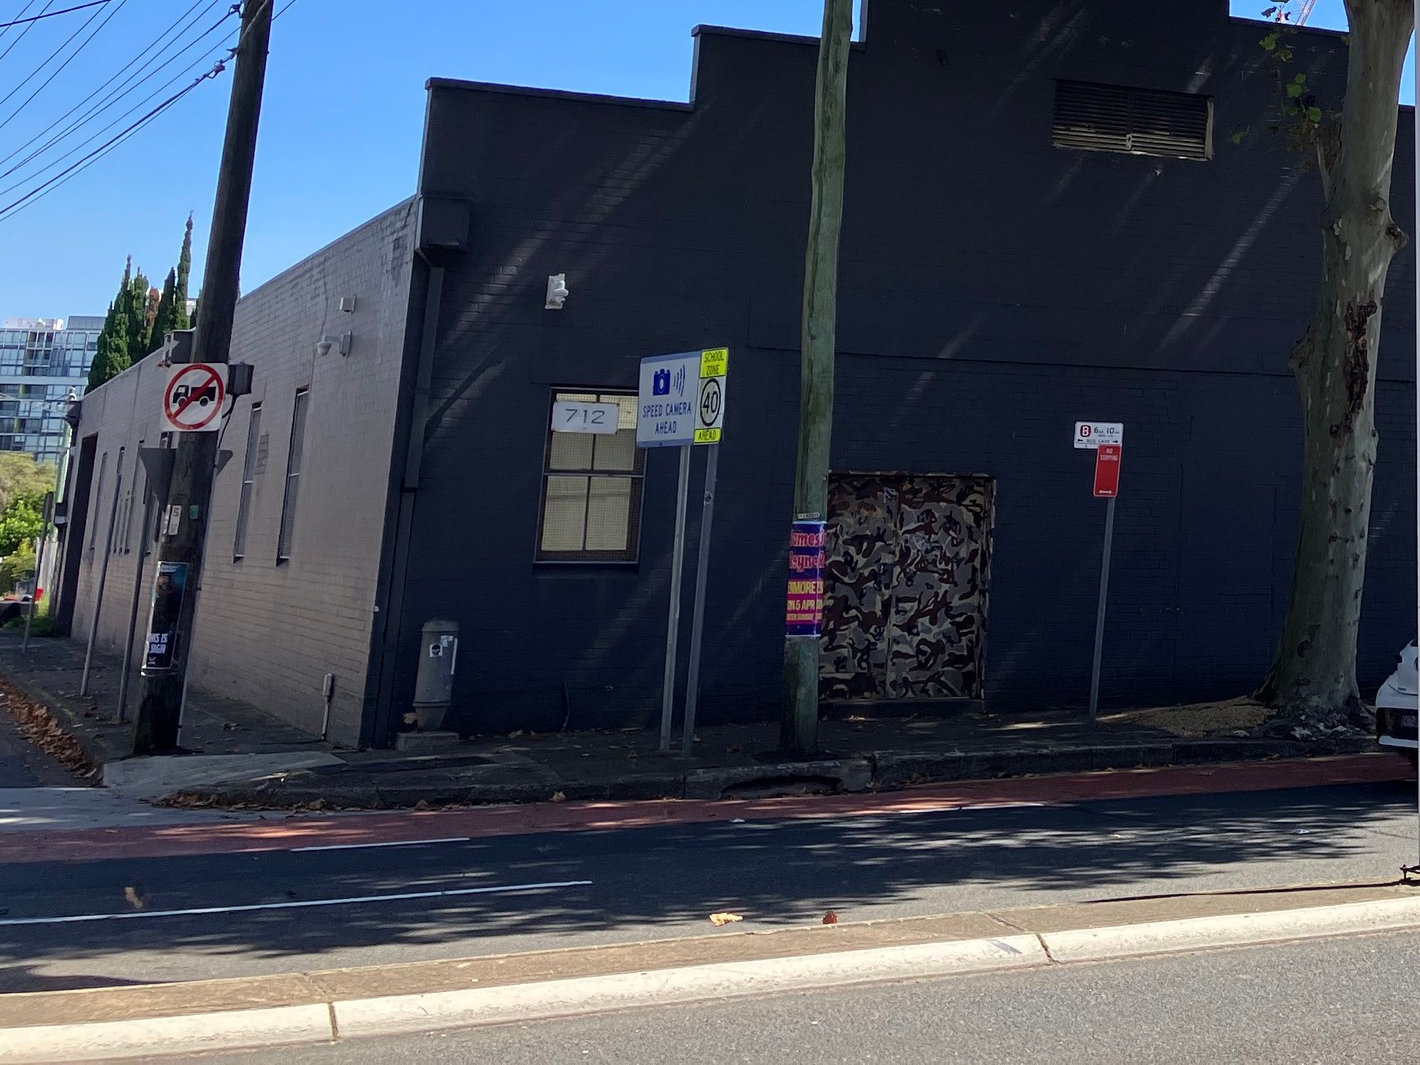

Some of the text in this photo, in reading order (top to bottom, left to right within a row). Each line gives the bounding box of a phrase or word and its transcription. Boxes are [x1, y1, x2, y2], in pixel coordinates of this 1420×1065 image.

[704, 351, 725, 363] SCHOOL
[706, 364, 720, 376] ZONE
[703, 391, 718, 414] 40
[642, 401, 692, 418] SPEED CAMERA
[565, 408, 605, 425] 712
[655, 422, 677, 435] AHEAD
[698, 429, 717, 441] AHEAD
